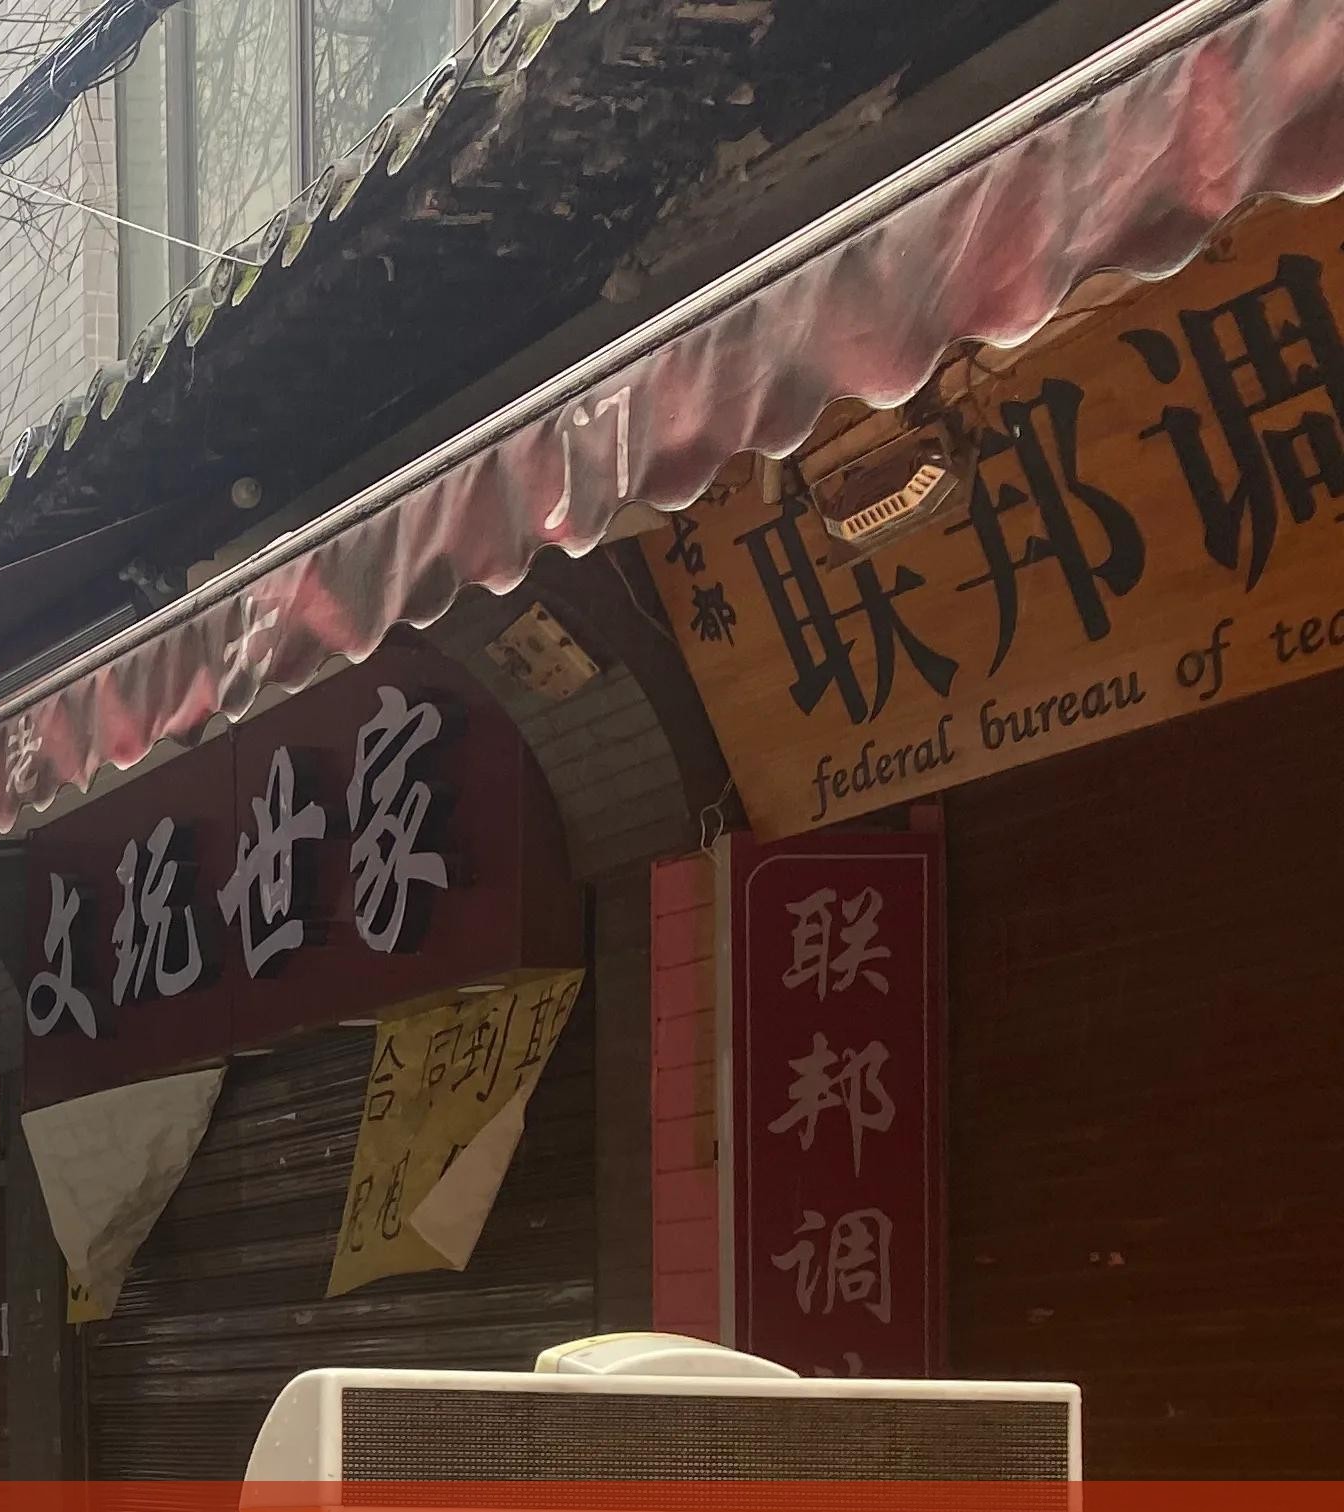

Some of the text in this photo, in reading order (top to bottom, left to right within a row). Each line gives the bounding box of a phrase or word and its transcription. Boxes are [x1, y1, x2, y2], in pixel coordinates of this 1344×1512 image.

[735, 254, 1344, 726] 联邦调
[26, 686, 448, 1039] 文玩世家
[810, 714, 958, 824] federal
[980, 665, 1147, 753] bureau
[1175, 617, 1235, 701] of
[367, 979, 578, 1122] 合同到期
[768, 885, 897, 1379] 联邦调
